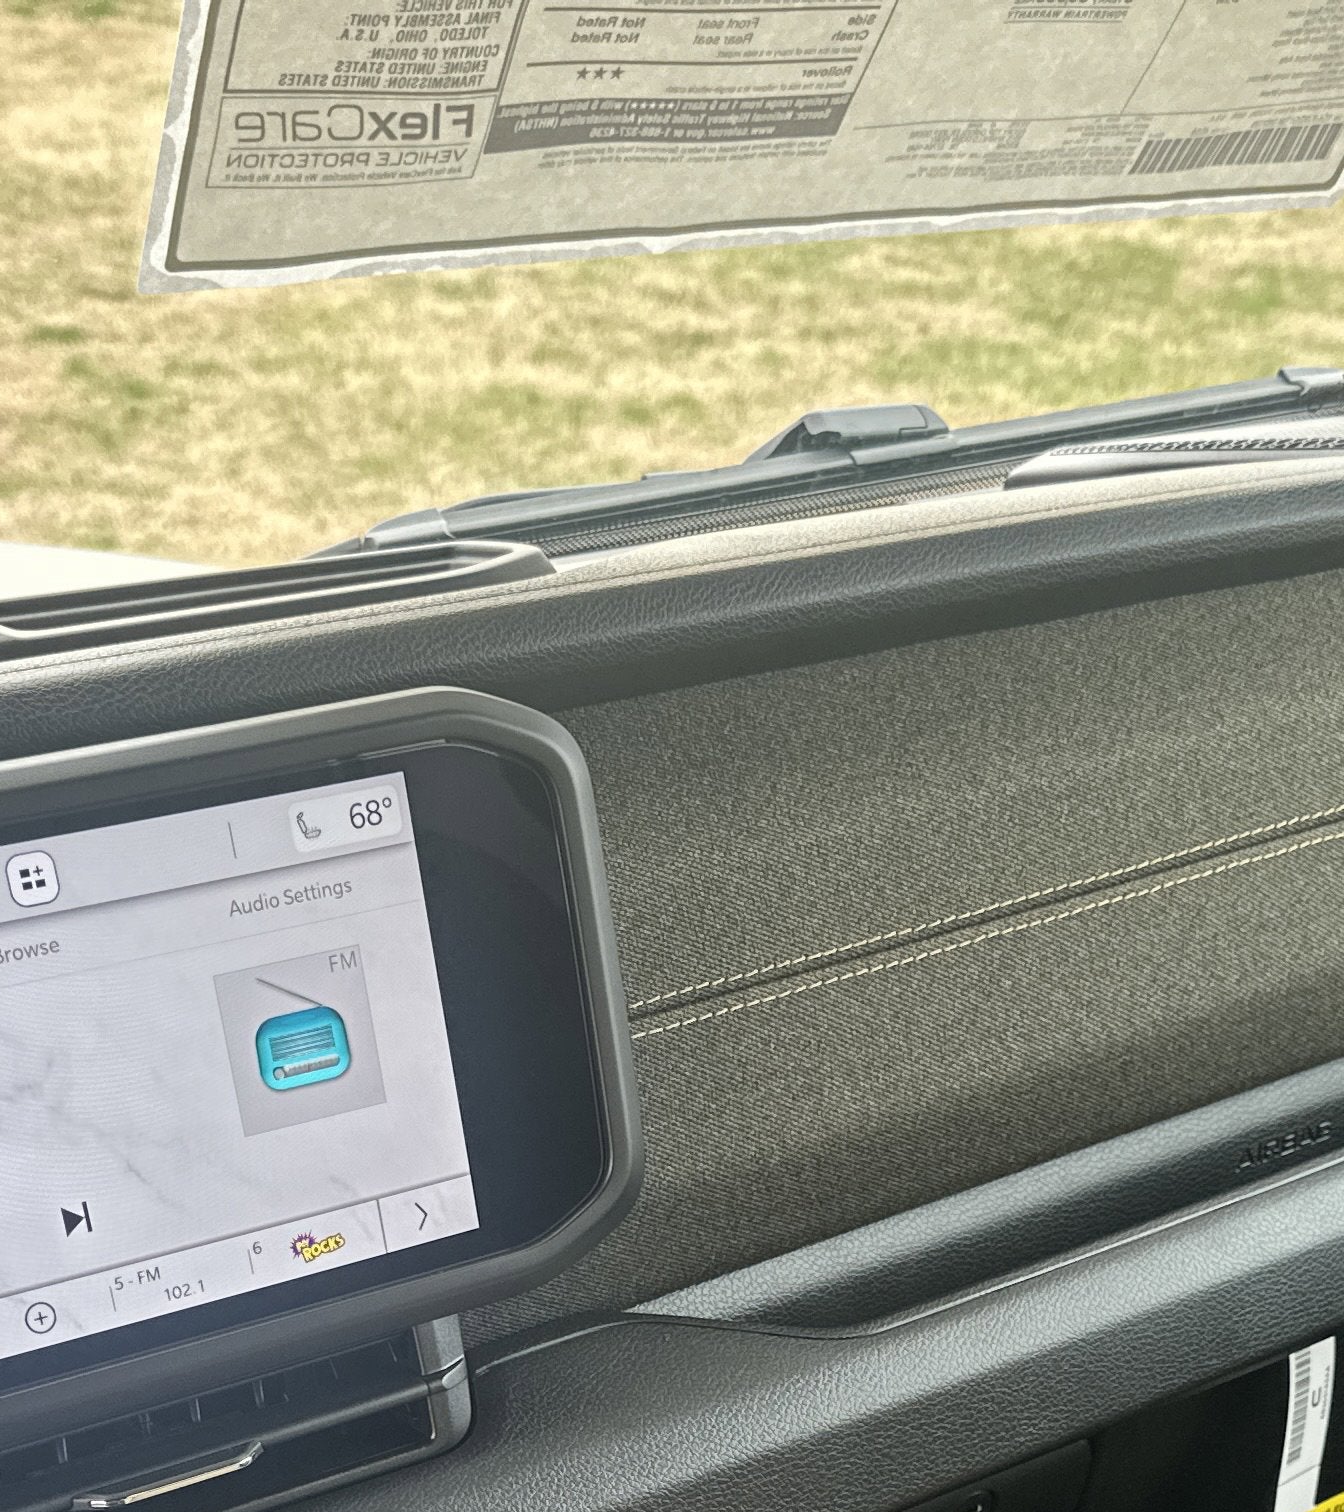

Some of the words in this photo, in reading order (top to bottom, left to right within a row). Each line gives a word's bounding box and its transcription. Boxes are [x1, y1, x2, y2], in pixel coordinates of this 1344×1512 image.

[349, 796, 394, 829] 68°
[228, 893, 278, 918] Audio
[282, 878, 353, 910] Settings
[328, 951, 358, 973] FM
[252, 1241, 263, 1257] 6
[302, 1234, 345, 1261] ROCKS
[114, 1276, 125, 1293] 5
[137, 1266, 162, 1285] FM
[163, 1279, 206, 1302] 102.1
